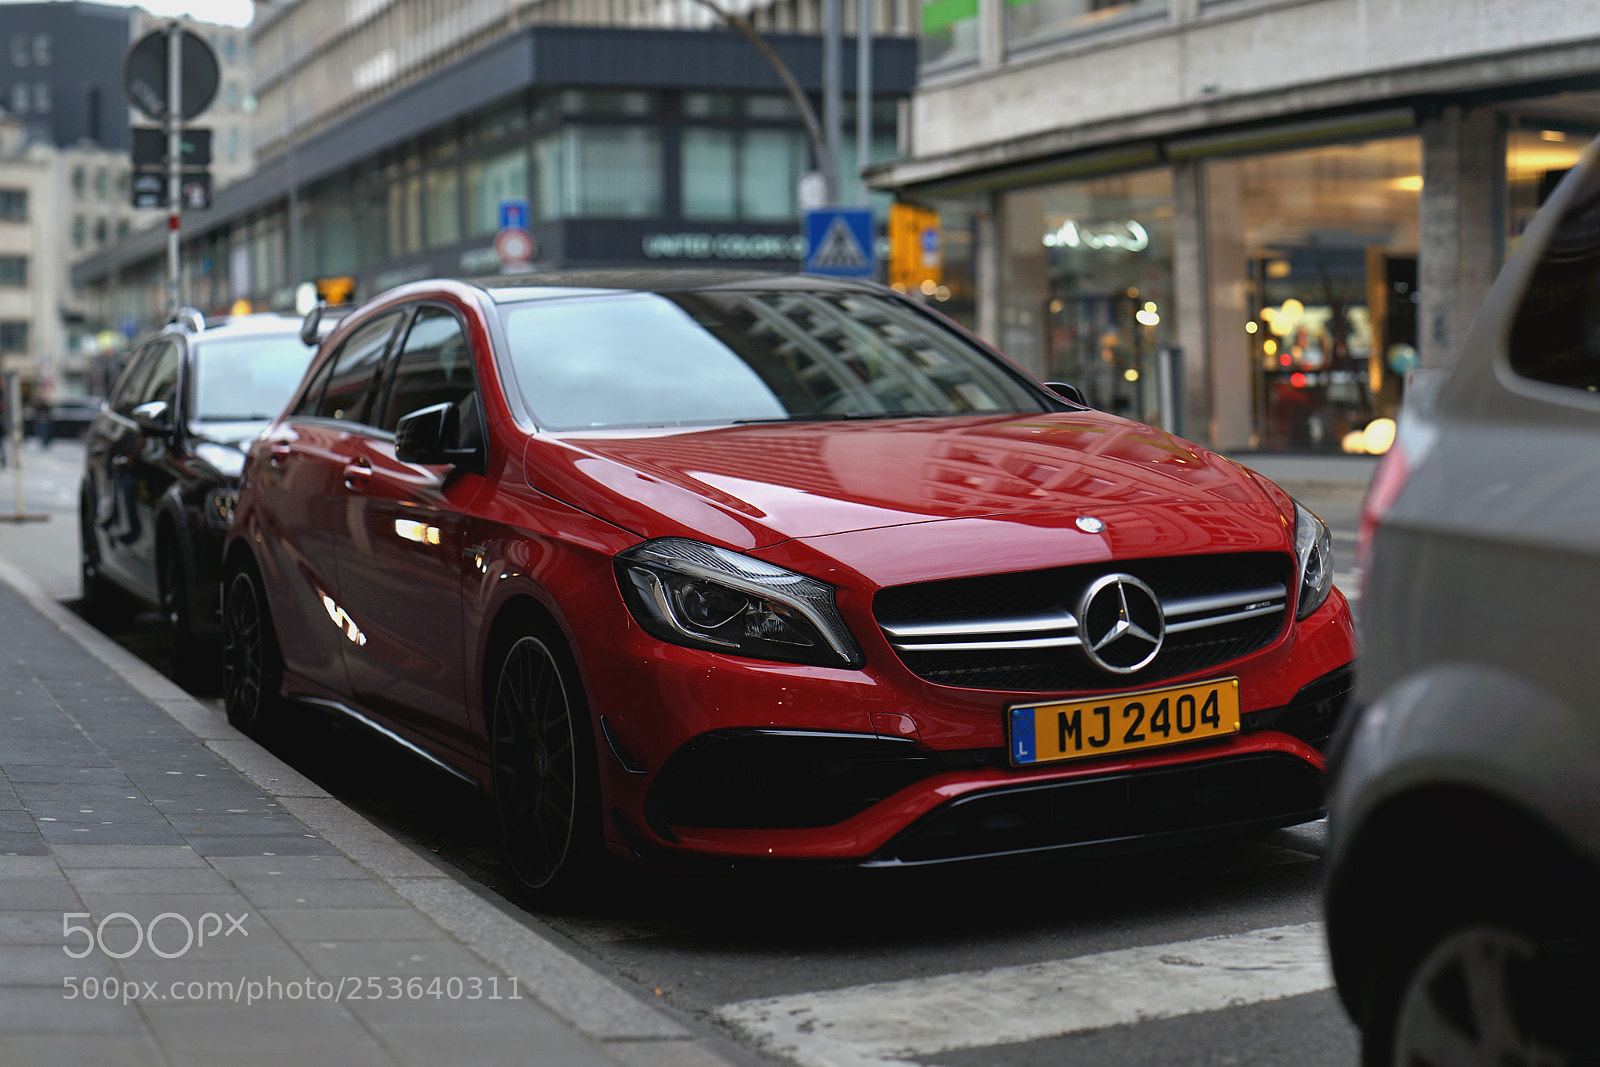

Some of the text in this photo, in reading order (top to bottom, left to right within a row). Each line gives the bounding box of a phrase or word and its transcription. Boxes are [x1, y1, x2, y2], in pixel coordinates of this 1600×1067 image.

[1057, 689, 1221, 753] MJ 2404
[1018, 741, 1028, 756] L
